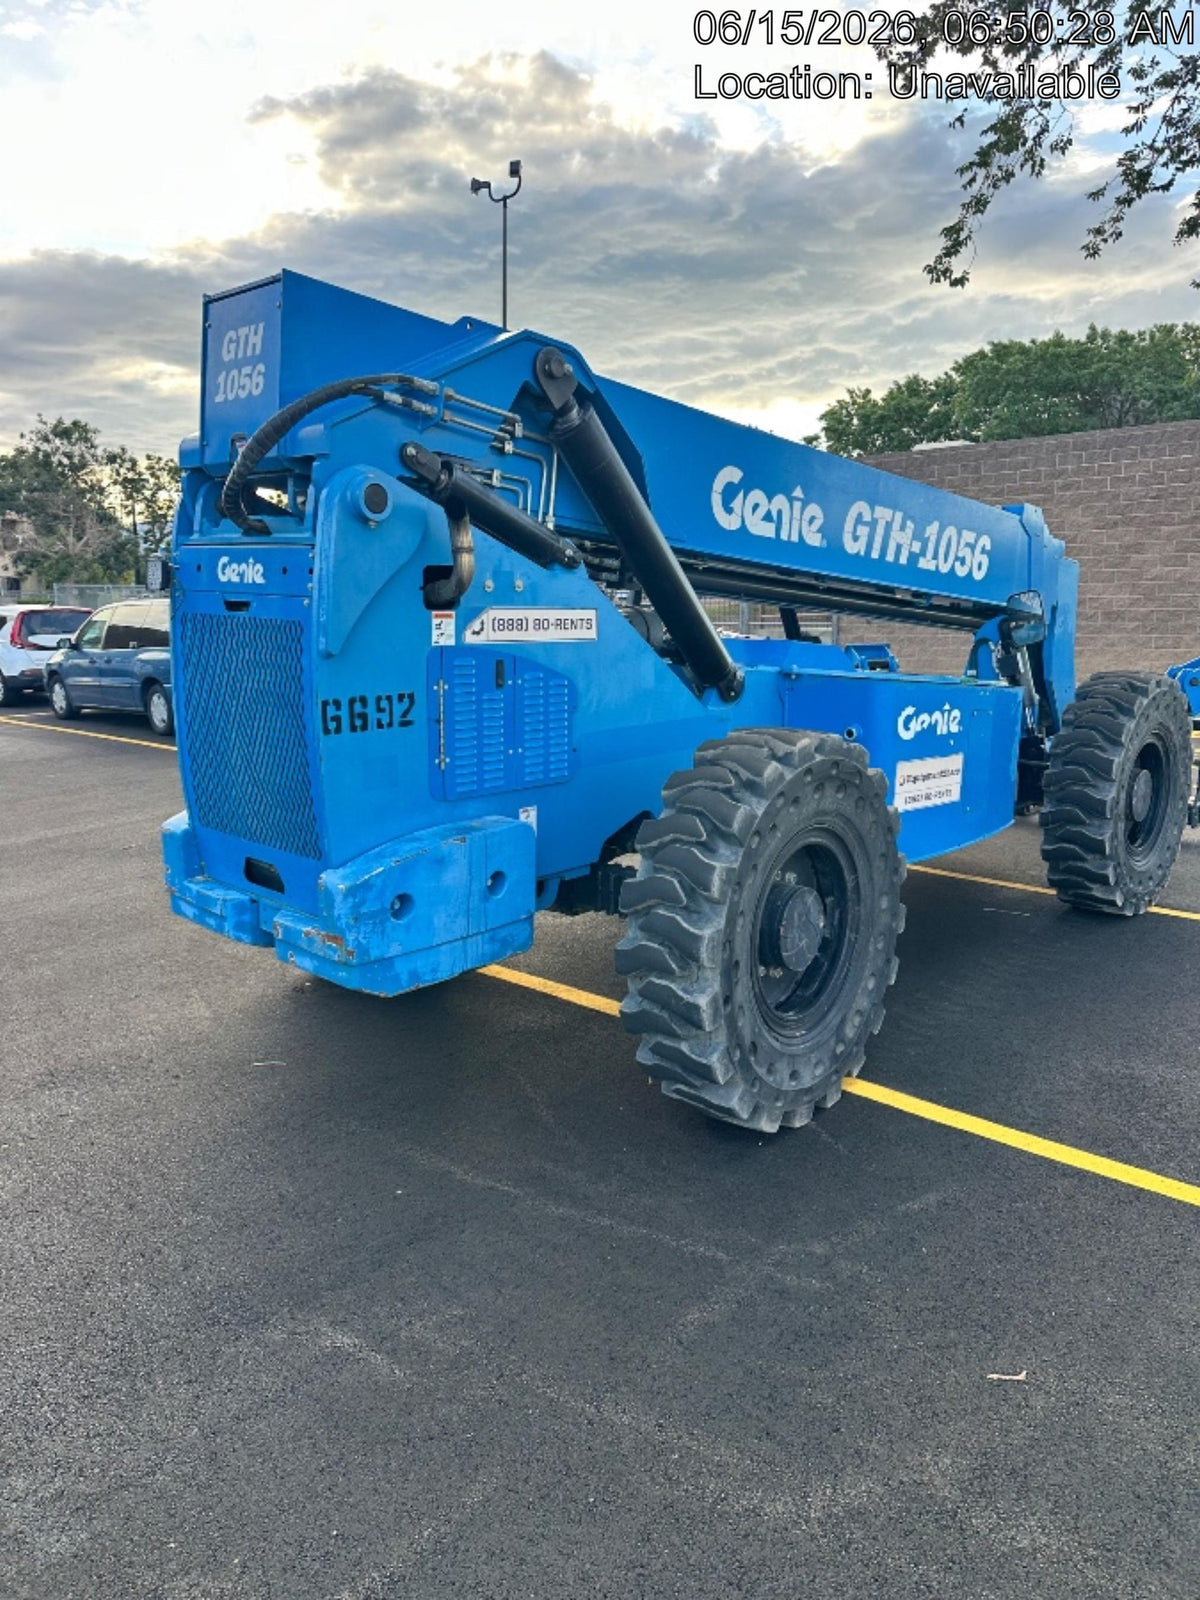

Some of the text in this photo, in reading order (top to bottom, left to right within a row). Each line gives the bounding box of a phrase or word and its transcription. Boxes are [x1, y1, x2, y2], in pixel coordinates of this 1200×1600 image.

[221, 321, 265, 362] GTH
[214, 363, 265, 403] 1056
[711, 465, 991, 581] Genie GTH-1056
[217, 556, 265, 584] Genie
[491, 616, 529, 632] (888)
[897, 701, 961, 740] Genie
